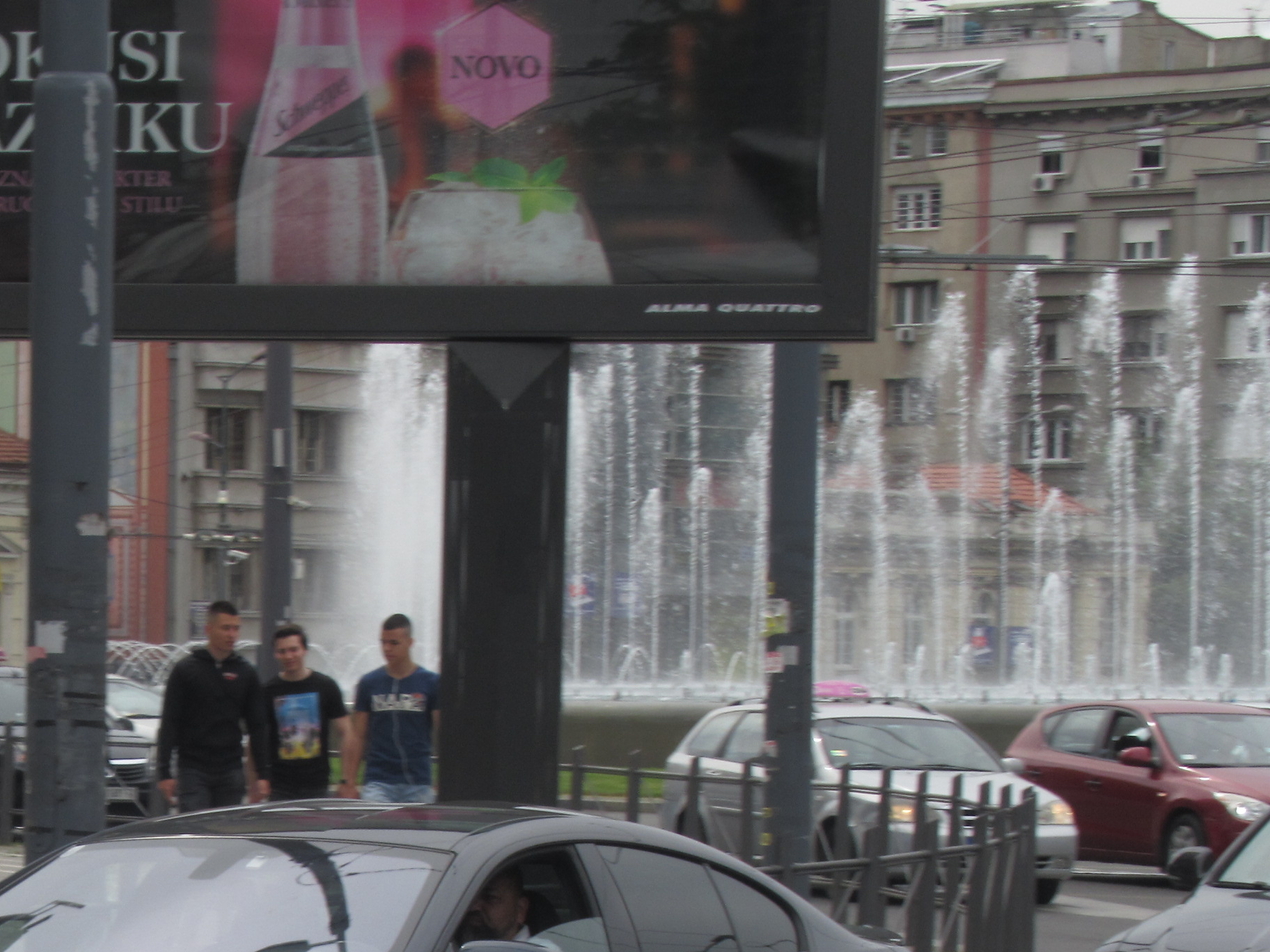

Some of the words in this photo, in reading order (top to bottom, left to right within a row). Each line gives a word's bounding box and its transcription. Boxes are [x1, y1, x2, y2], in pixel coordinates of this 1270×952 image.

[450, 55, 541, 79] NOVO
[644, 303, 709, 313] ALMA
[716, 303, 822, 314] QUATTRO
